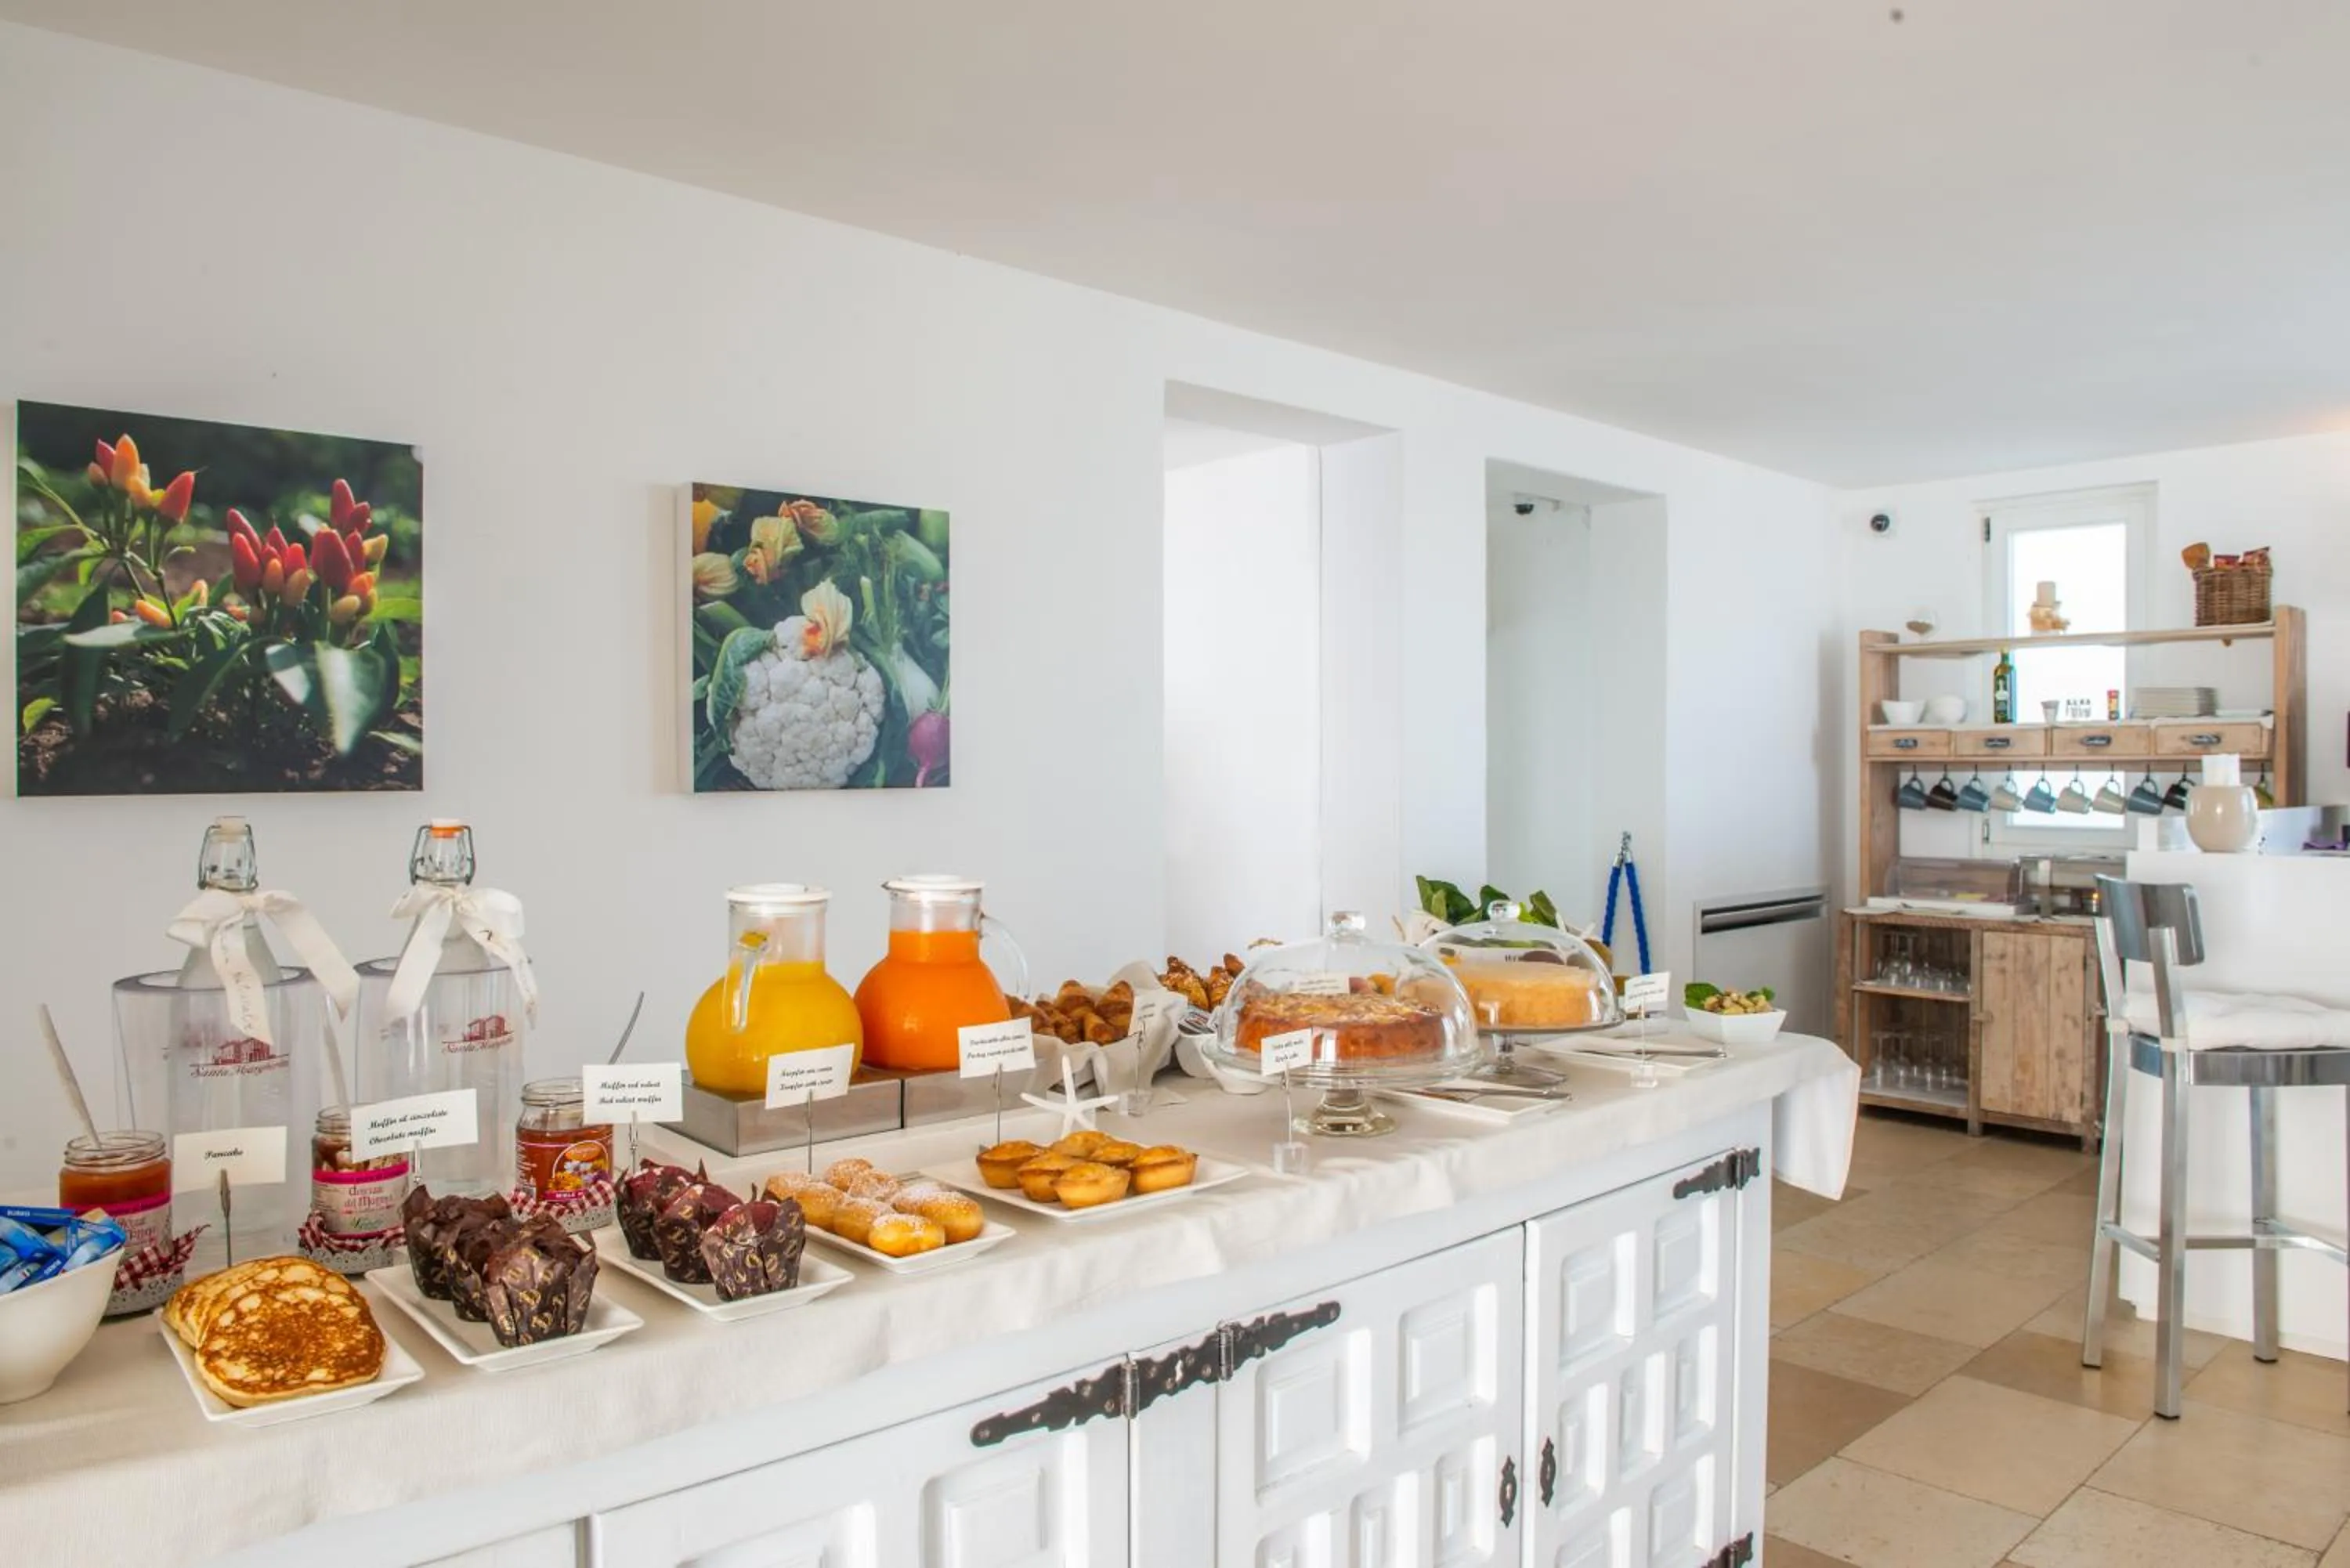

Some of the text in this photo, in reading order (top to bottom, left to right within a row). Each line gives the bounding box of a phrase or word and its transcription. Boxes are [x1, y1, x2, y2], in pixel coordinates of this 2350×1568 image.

[598, 1081, 626, 1091] Muffin
[598, 1095, 614, 1105] Red
[637, 1094, 662, 1104] muffin
[367, 1116, 397, 1130] Muffin
[399, 1115, 408, 1123] al
[368, 1126, 437, 1146] Chocolate muffin
[204, 1147, 244, 1161] Pancake
